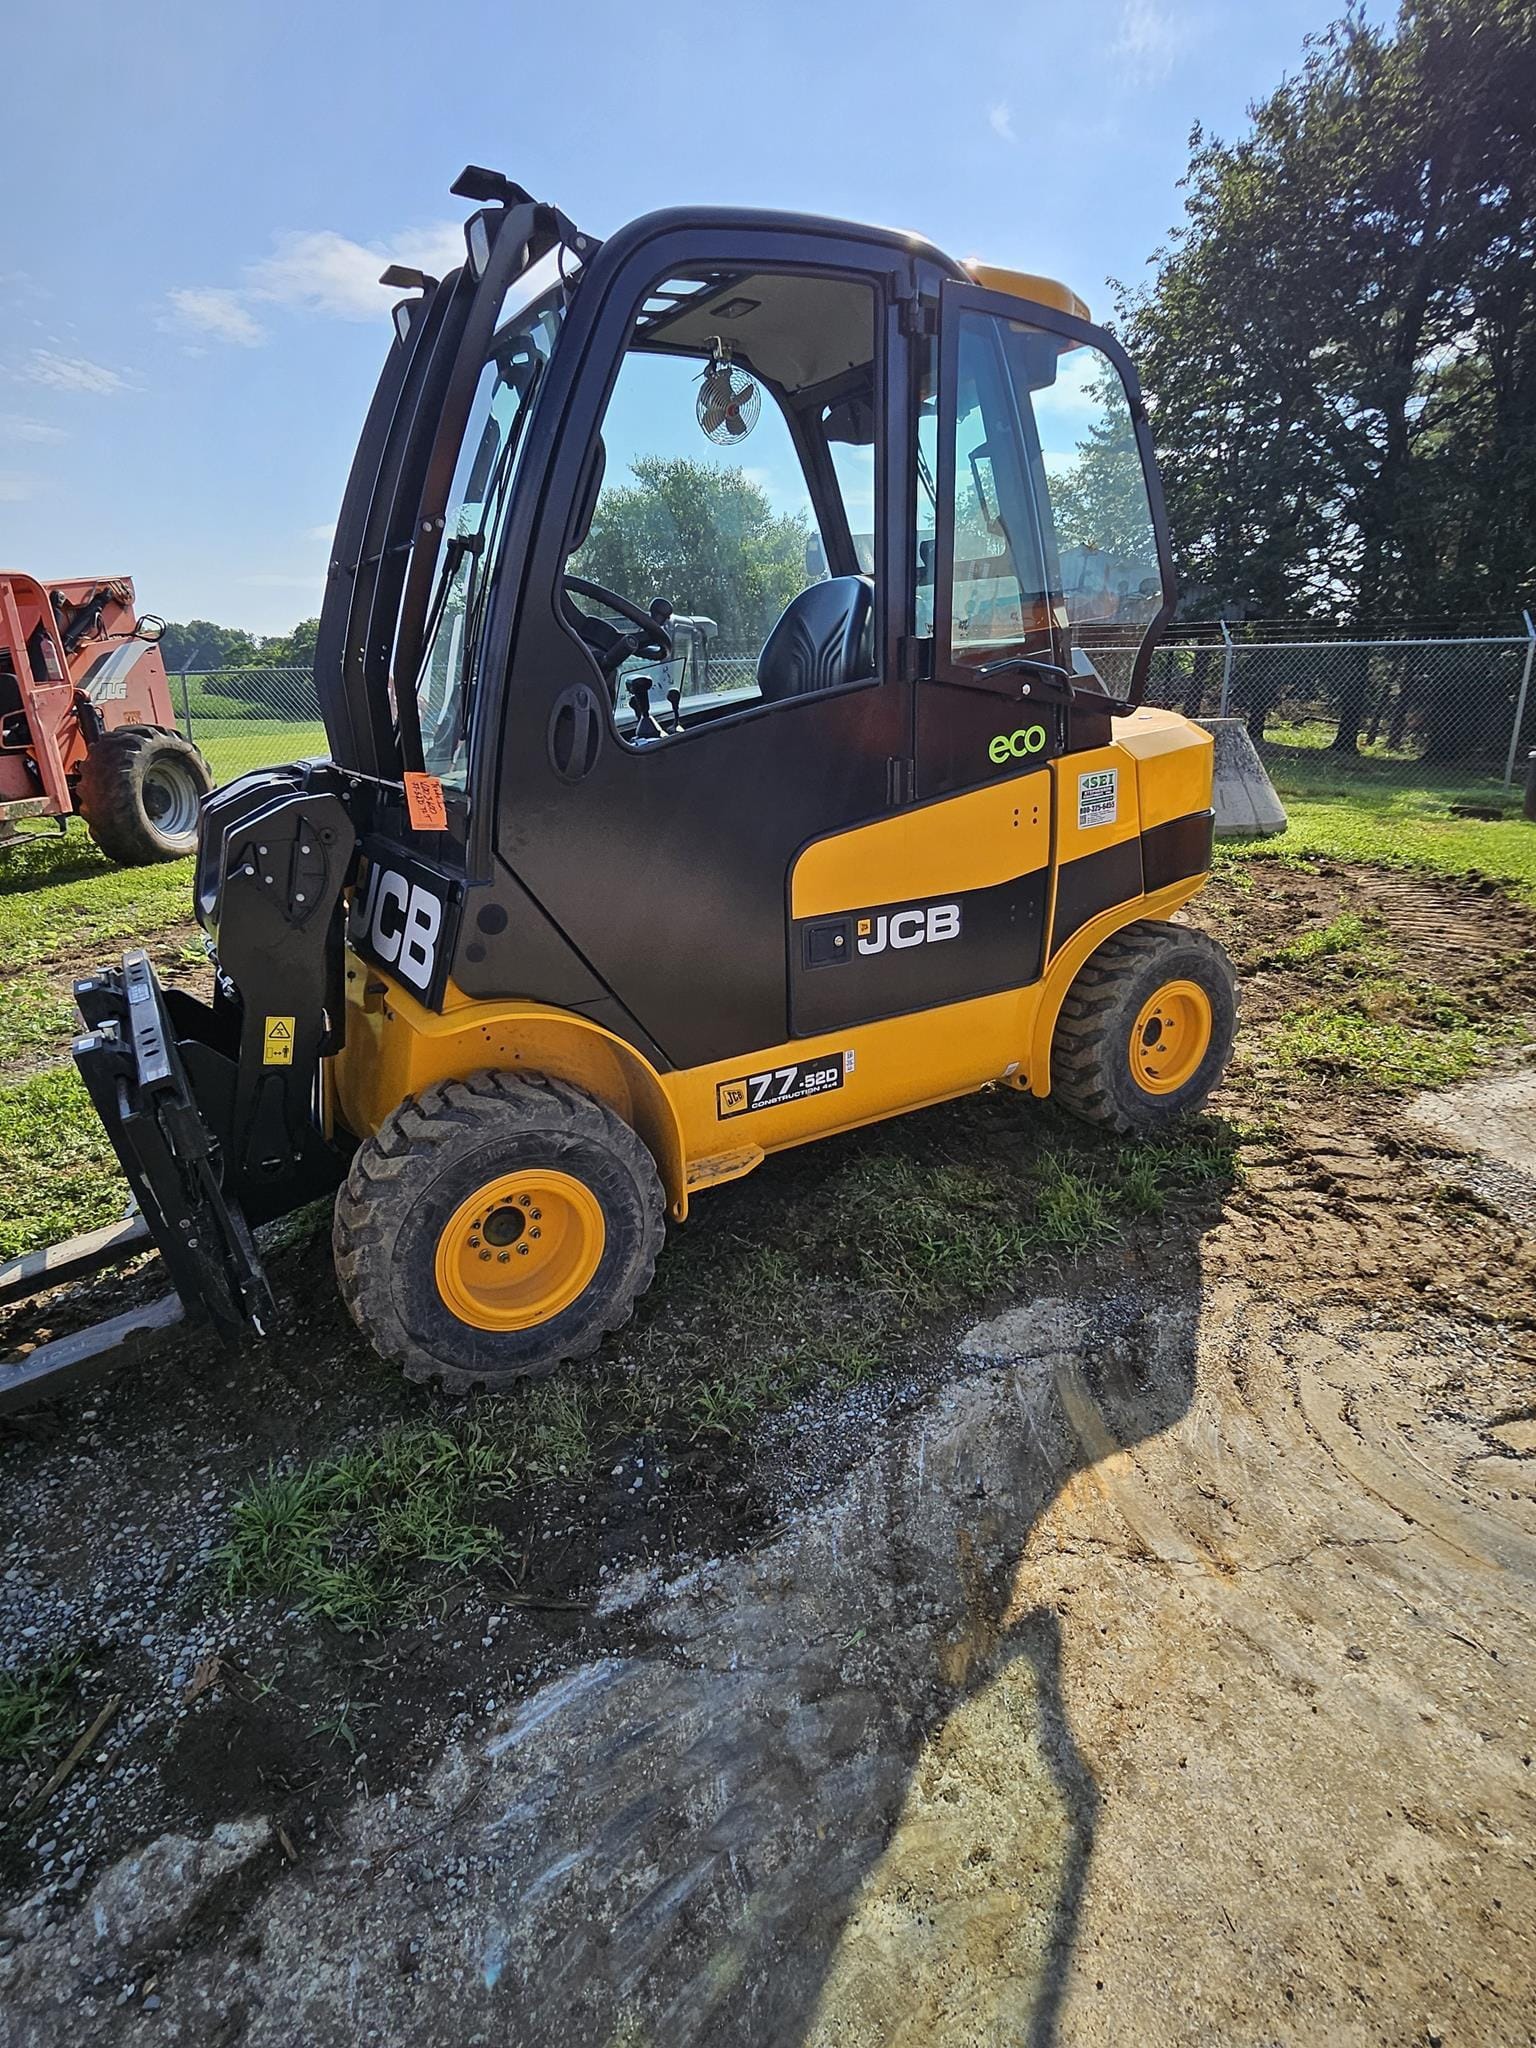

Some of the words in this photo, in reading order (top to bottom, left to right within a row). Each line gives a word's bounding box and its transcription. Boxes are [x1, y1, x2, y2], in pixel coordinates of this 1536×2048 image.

[96, 683, 127, 700] JLG
[988, 725, 1046, 763] eco
[1090, 773, 1114, 788] SEI
[350, 861, 441, 990] JCB
[858, 904, 960, 955] JCB
[726, 1090, 744, 1106] JCB
[751, 1085, 821, 1109] CONSTRUCTION
[822, 1081, 838, 1090] 4x4
